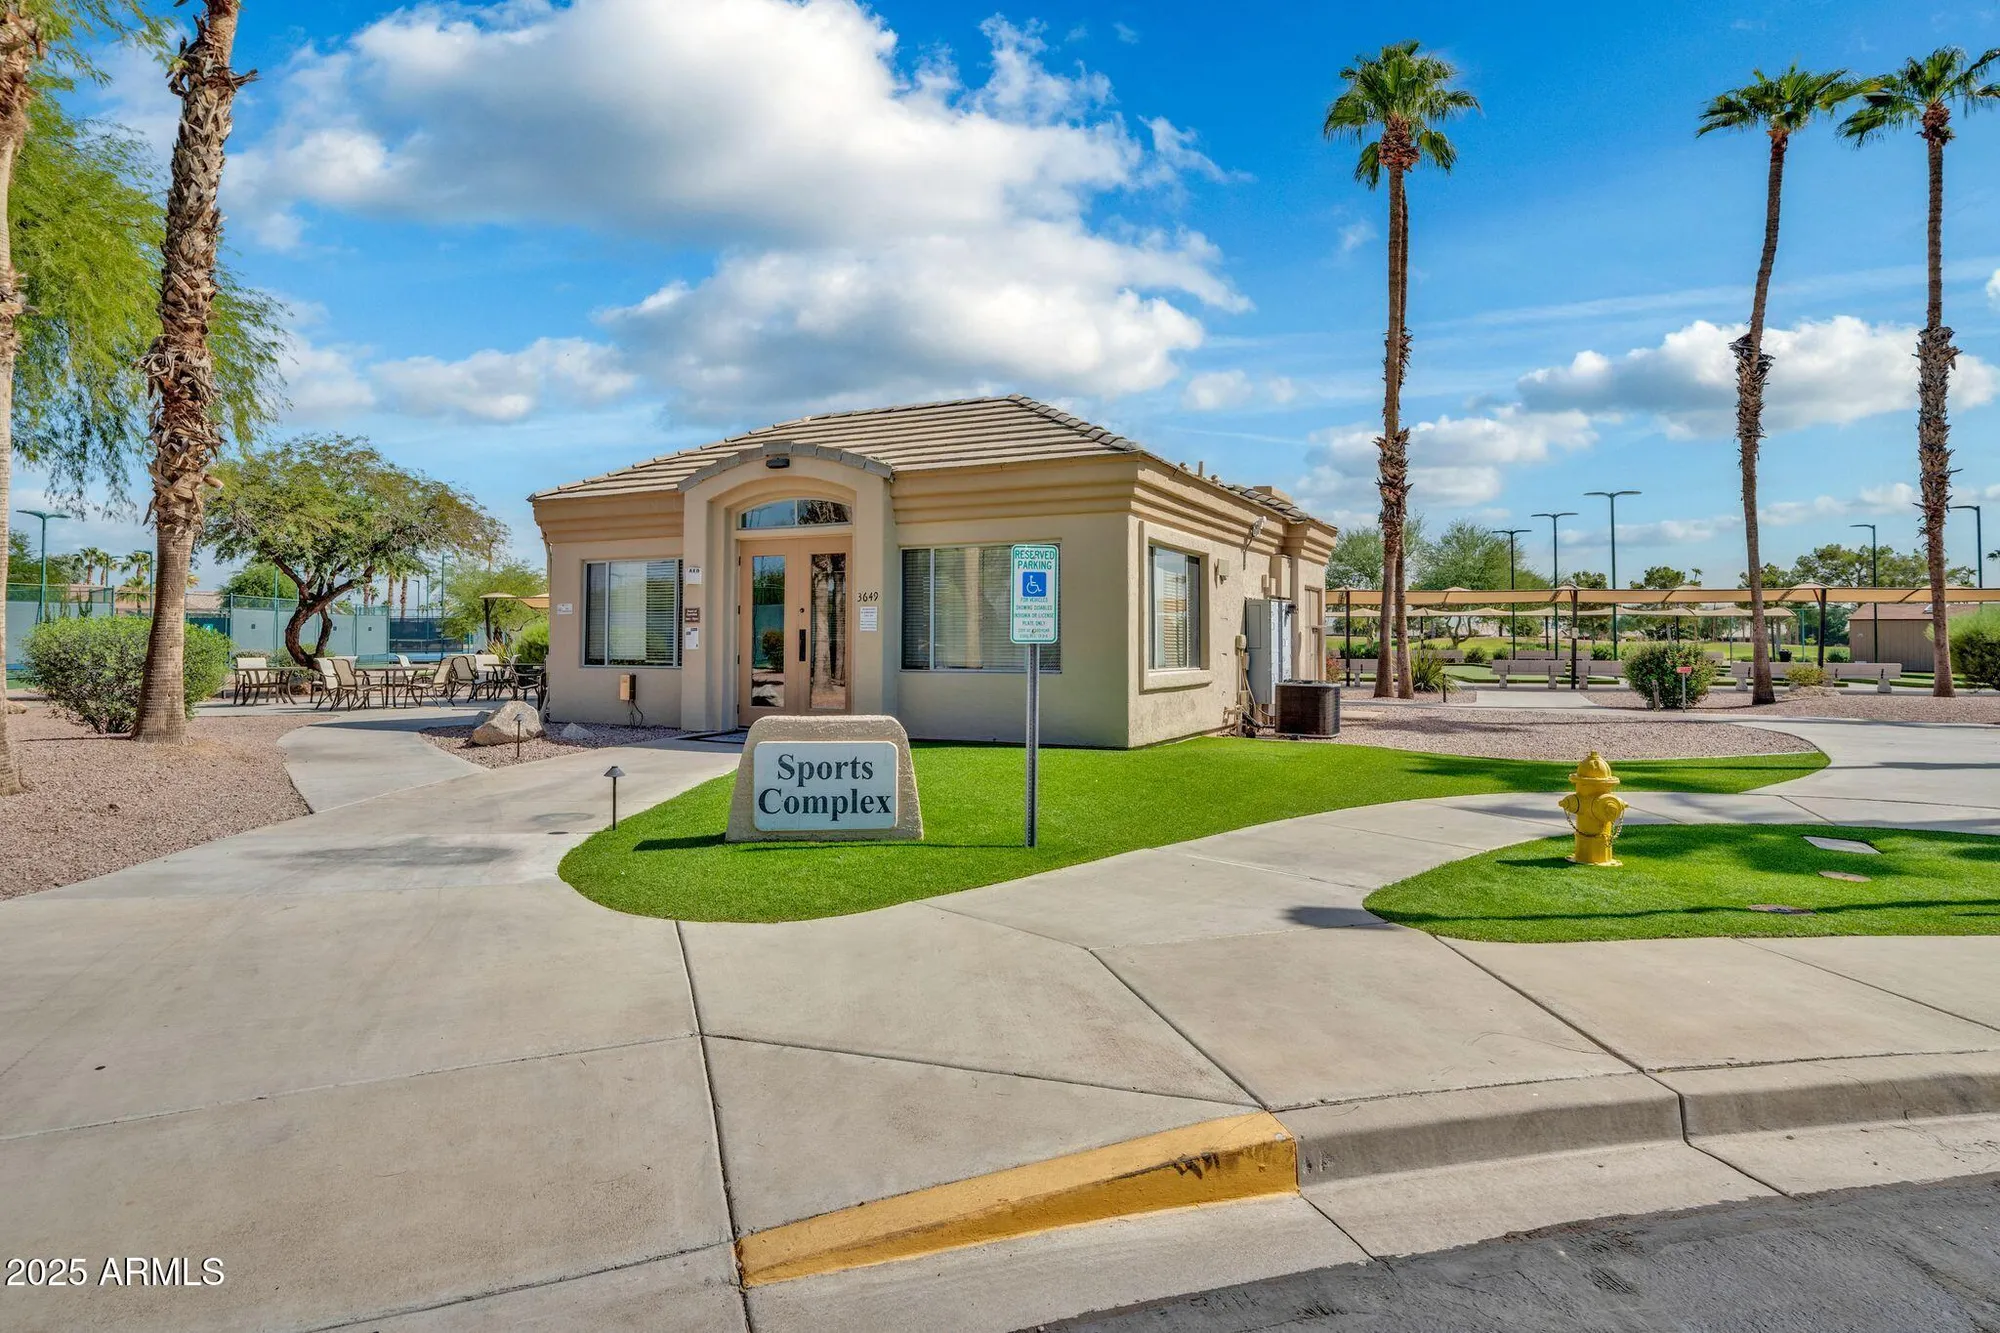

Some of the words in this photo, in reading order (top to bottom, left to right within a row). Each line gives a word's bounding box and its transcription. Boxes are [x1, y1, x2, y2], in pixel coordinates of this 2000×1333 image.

[1015, 550, 1055, 560] RESERVED
[1017, 560, 1052, 570] PARKING
[857, 591, 879, 602] 3649
[777, 754, 874, 787] Sports
[758, 788, 892, 821] Complex
